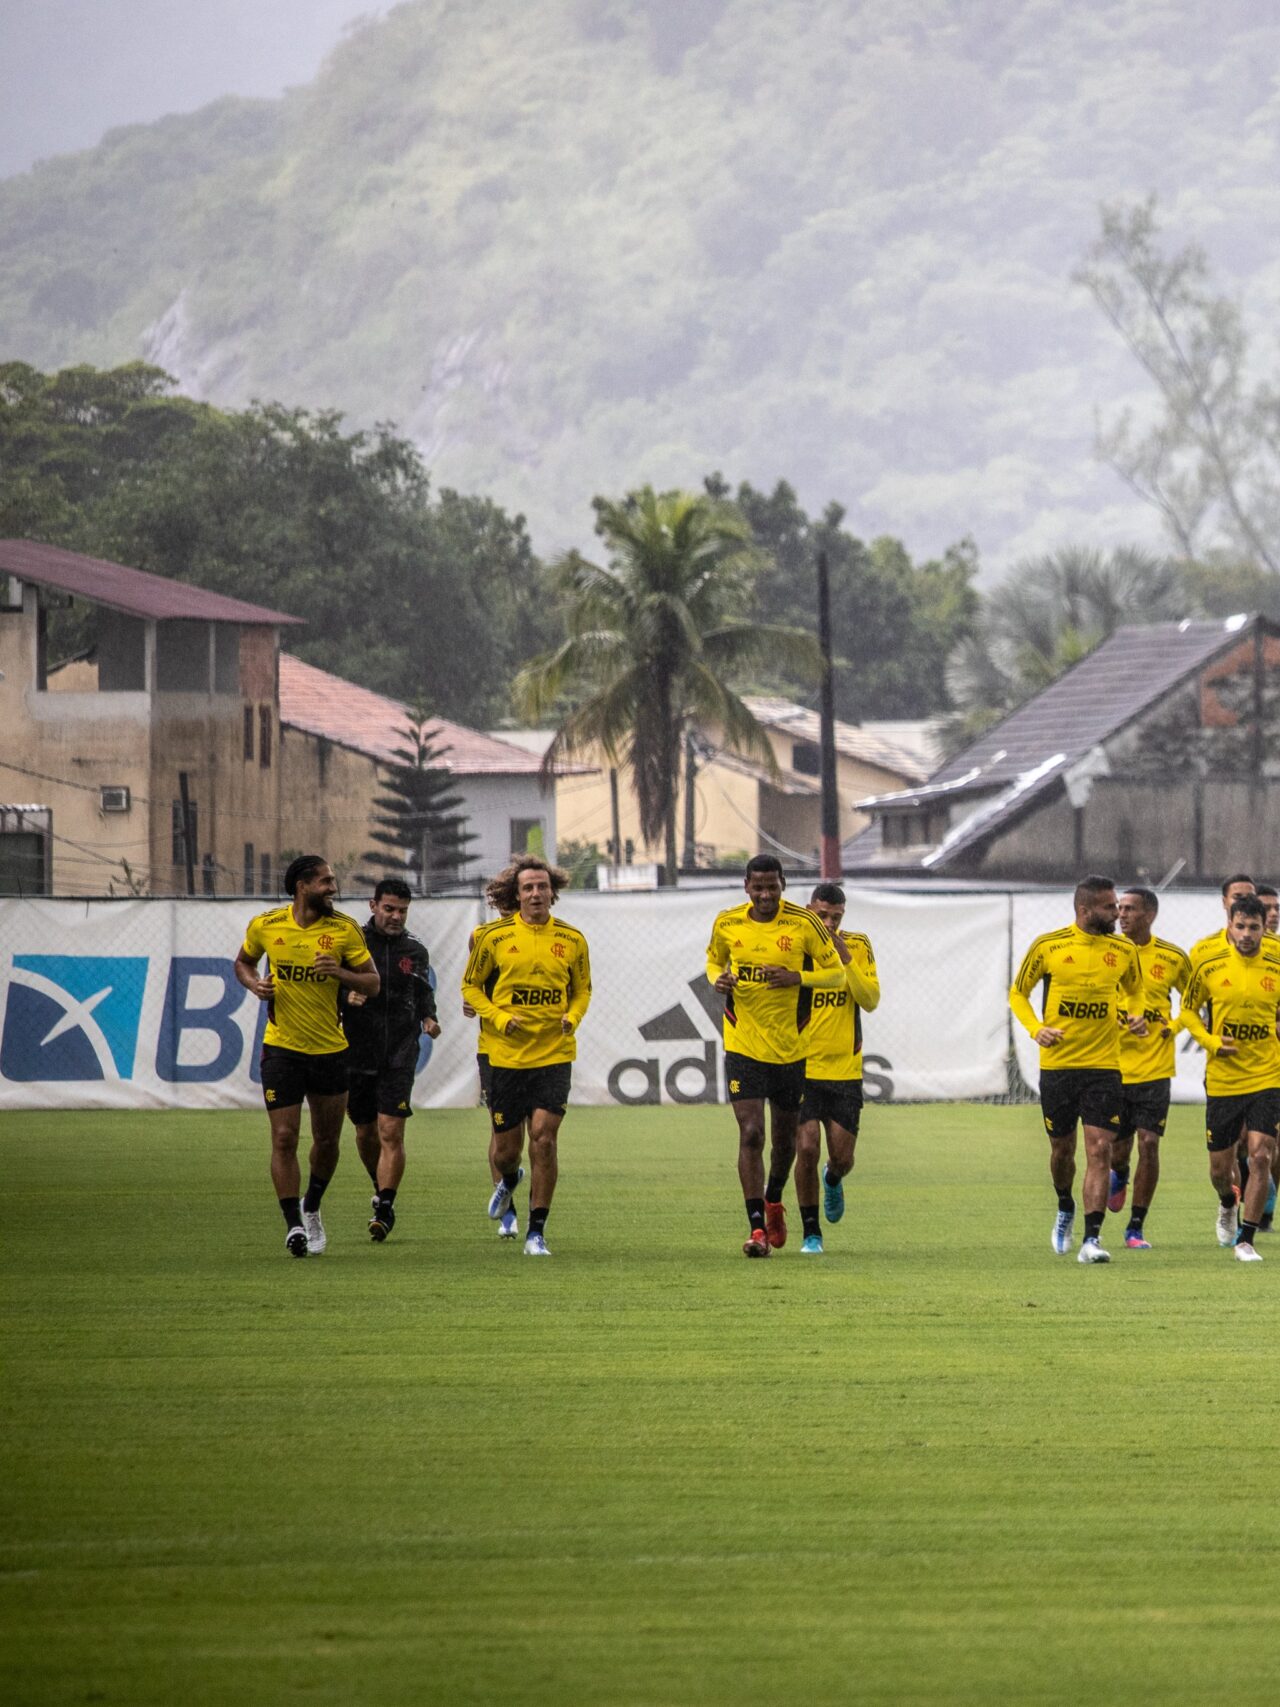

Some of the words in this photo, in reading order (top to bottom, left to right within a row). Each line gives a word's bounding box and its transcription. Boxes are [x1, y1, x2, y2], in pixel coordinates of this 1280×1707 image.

[529, 989, 561, 1005] BRB
[814, 991, 847, 1008] BRB
[1075, 1002, 1108, 1019] BRB
[1238, 1024, 1269, 1040] BRB
